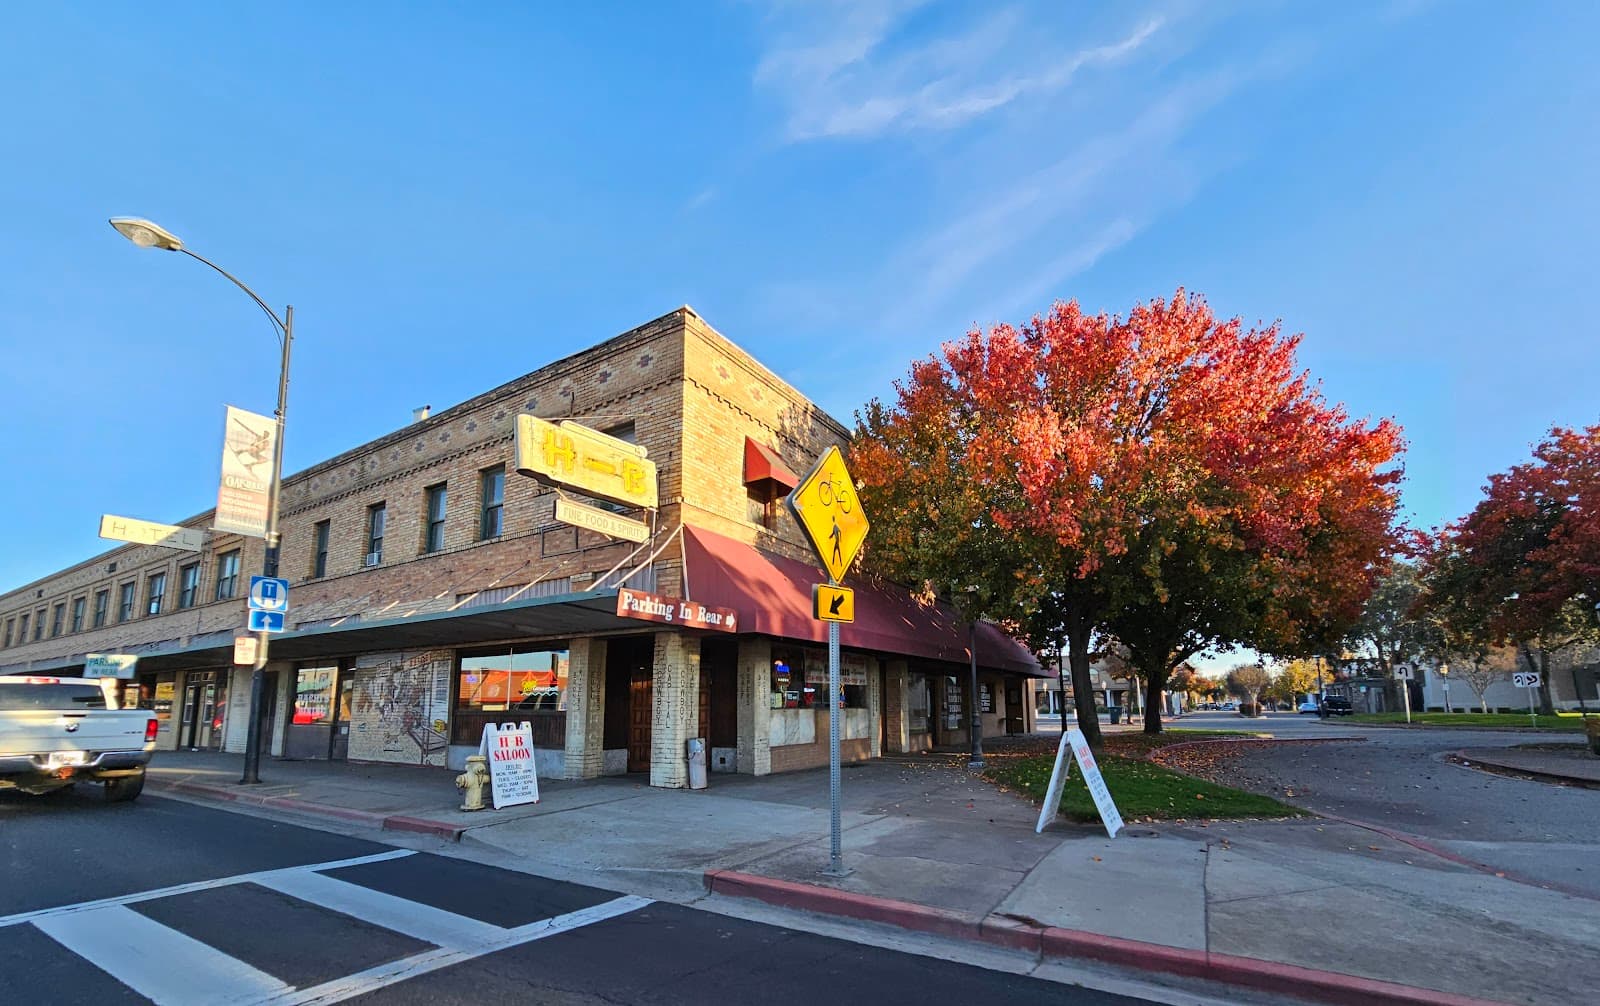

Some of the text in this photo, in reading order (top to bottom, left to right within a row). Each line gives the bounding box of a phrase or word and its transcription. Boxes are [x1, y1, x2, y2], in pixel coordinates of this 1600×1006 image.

[563, 507, 584, 522] FINE
[585, 511, 609, 529] FOOD
[617, 523, 645, 538] SPIRITS
[622, 591, 722, 625] Parking In Rear
[493, 747, 531, 761] SALOON
